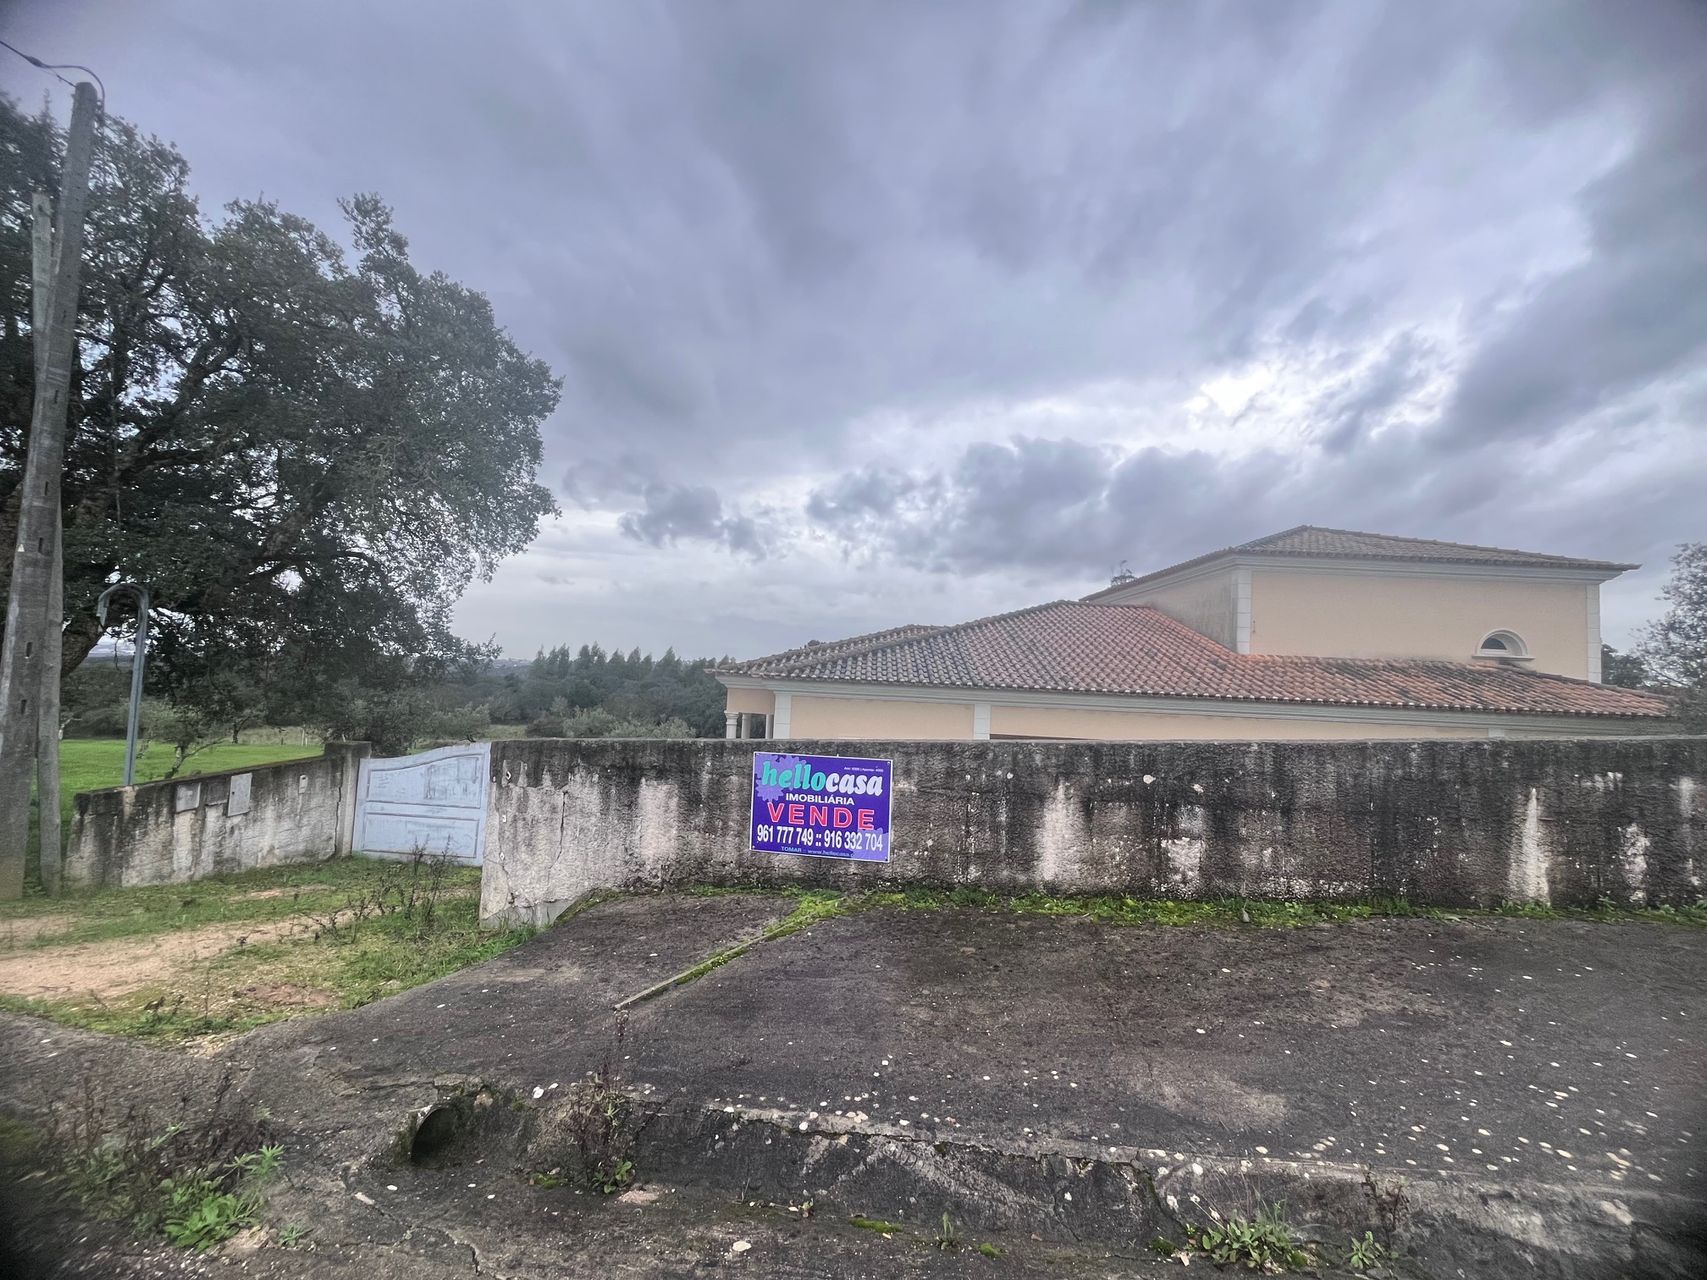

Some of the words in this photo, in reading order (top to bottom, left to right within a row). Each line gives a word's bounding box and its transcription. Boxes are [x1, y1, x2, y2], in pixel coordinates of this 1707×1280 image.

[762, 761, 883, 796] hellocasa
[785, 793, 855, 805] IMOBILIÁRIA
[767, 802, 874, 830] VENDE
[757, 824, 773, 842] 961
[776, 826, 794, 844] 777
[796, 828, 813, 846] 749
[824, 830, 842, 848] 916
[844, 831, 862, 850] 332
[865, 833, 883, 851] 704
